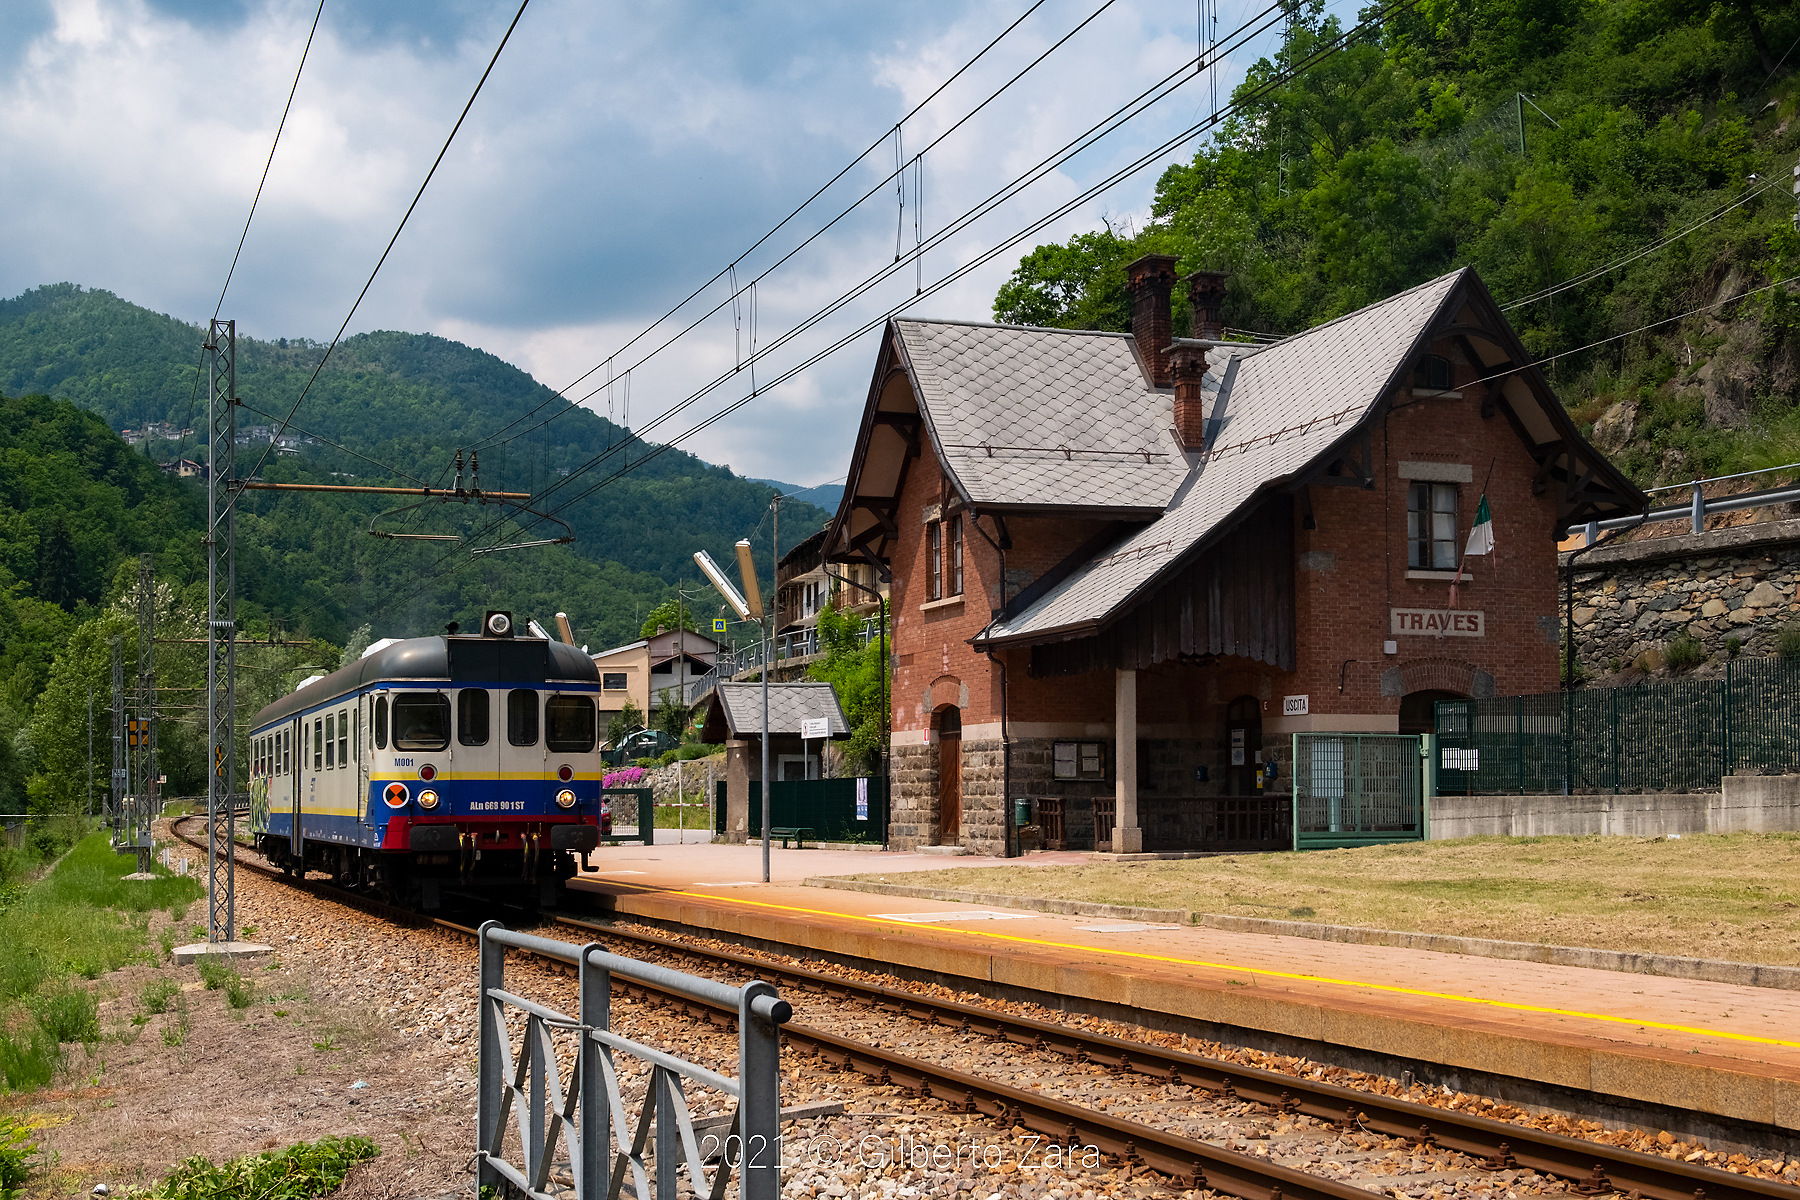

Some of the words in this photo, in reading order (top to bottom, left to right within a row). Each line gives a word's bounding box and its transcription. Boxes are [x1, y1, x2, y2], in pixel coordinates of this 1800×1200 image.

[1396, 612, 1479, 632] TRAVES
[1285, 698, 1307, 711] USCITA
[394, 758, 414, 767] M001
[469, 801, 484, 811] ALn
